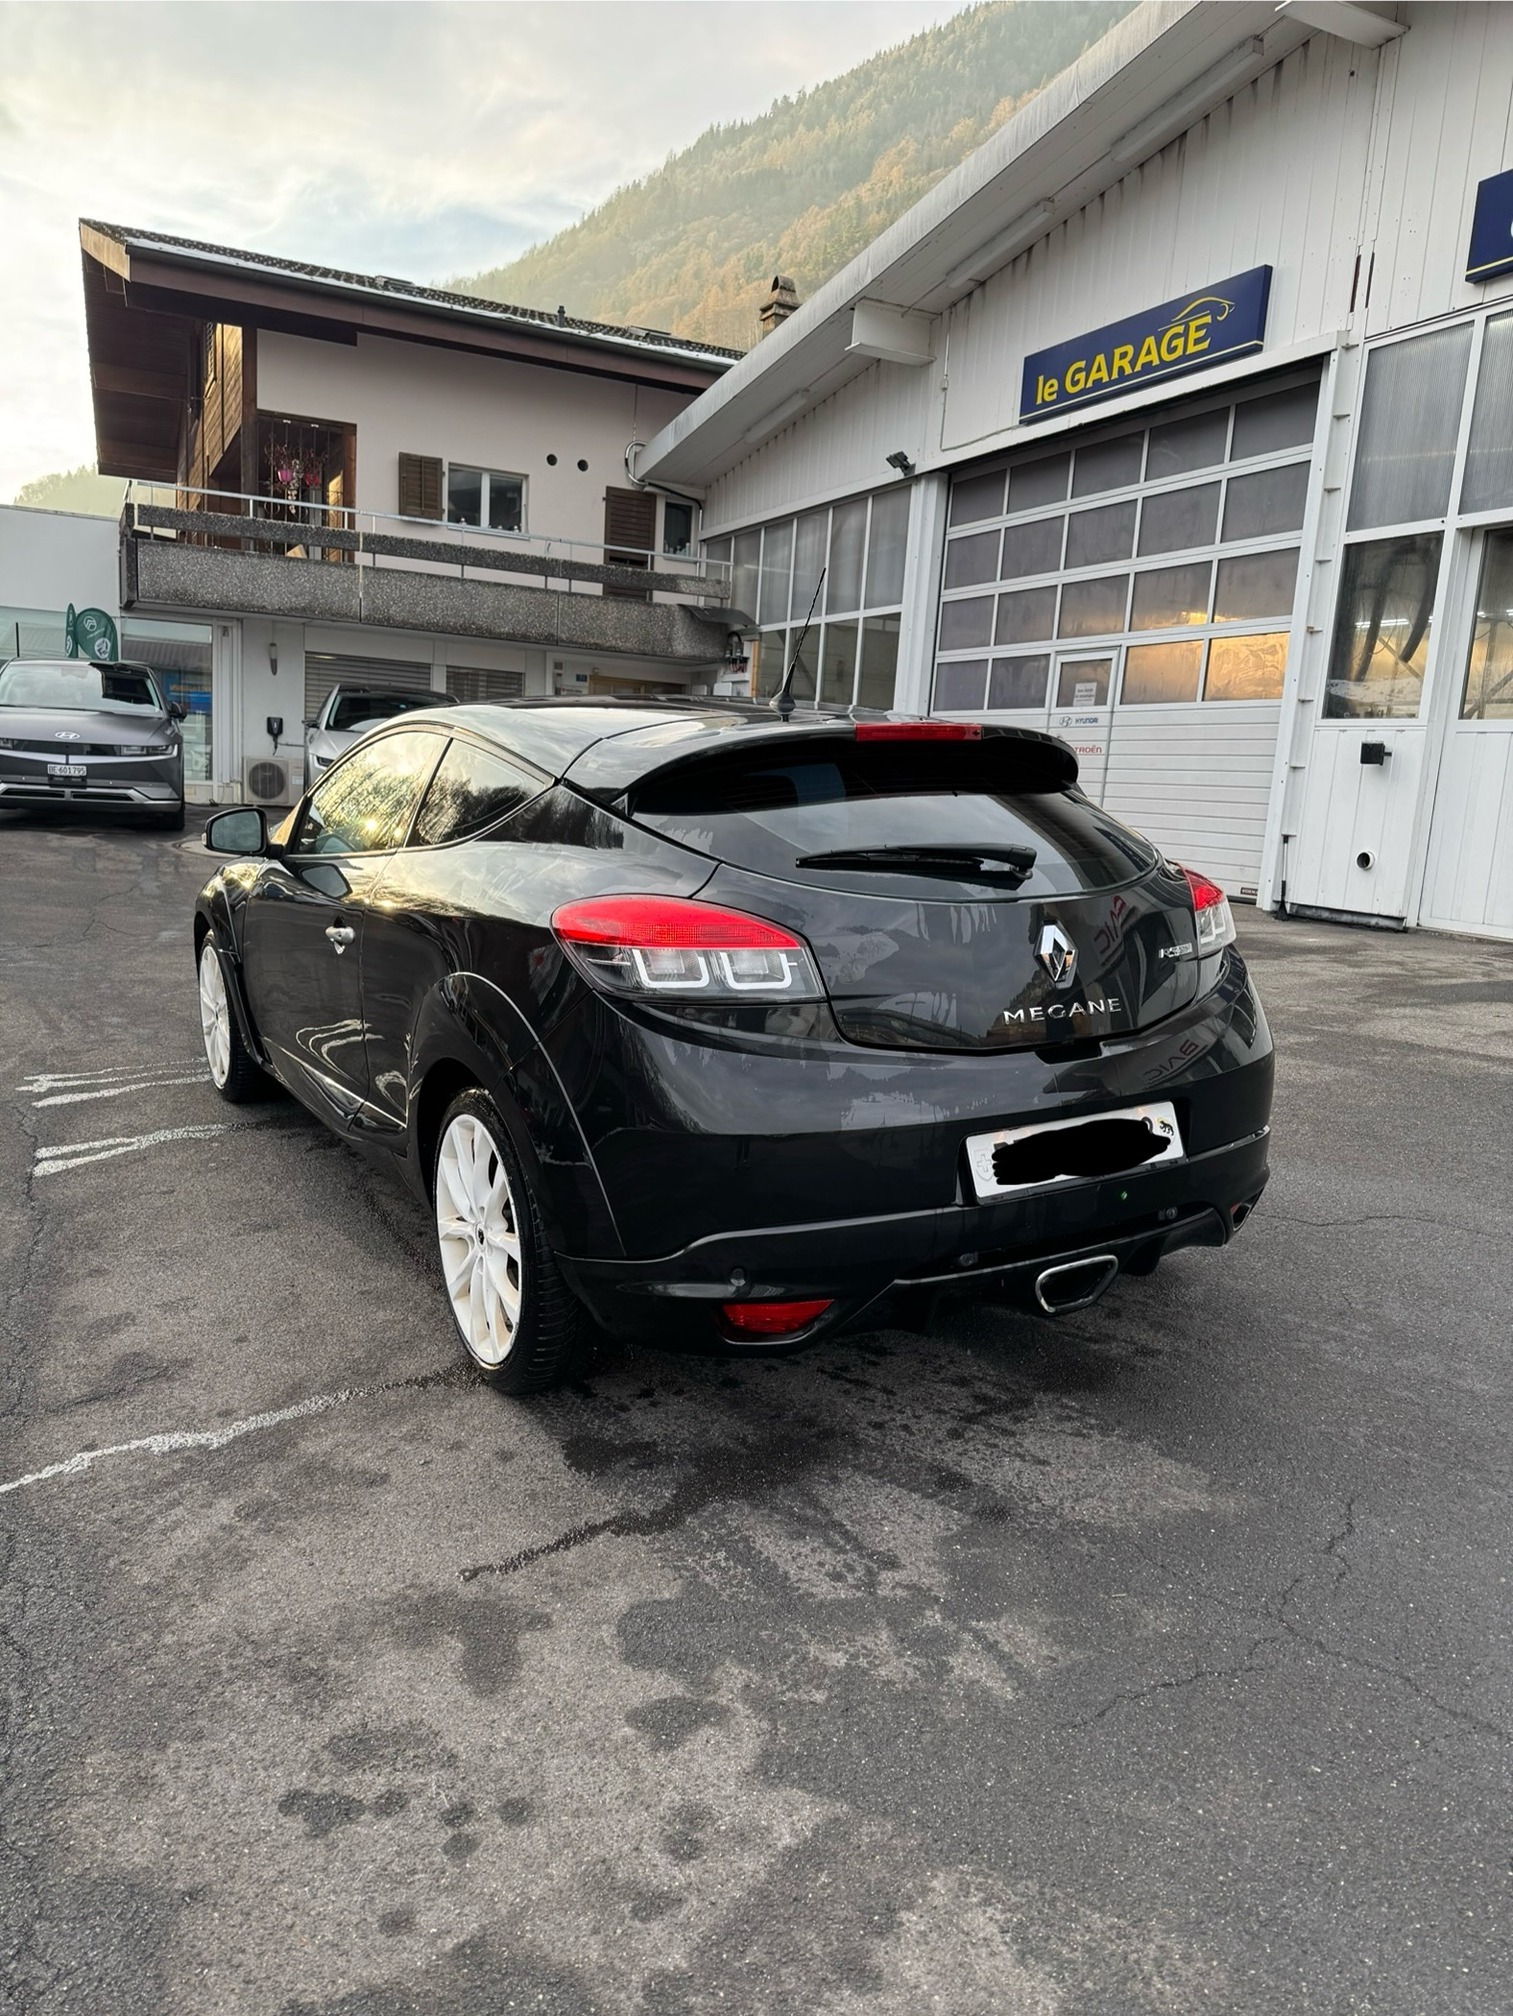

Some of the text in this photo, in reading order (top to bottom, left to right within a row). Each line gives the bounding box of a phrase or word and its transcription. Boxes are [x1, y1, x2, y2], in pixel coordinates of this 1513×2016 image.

[1035, 314, 1212, 405] le GARAGE
[1074, 745, 1102, 753] TROËN
[1003, 998, 1122, 1025] MEGANE
